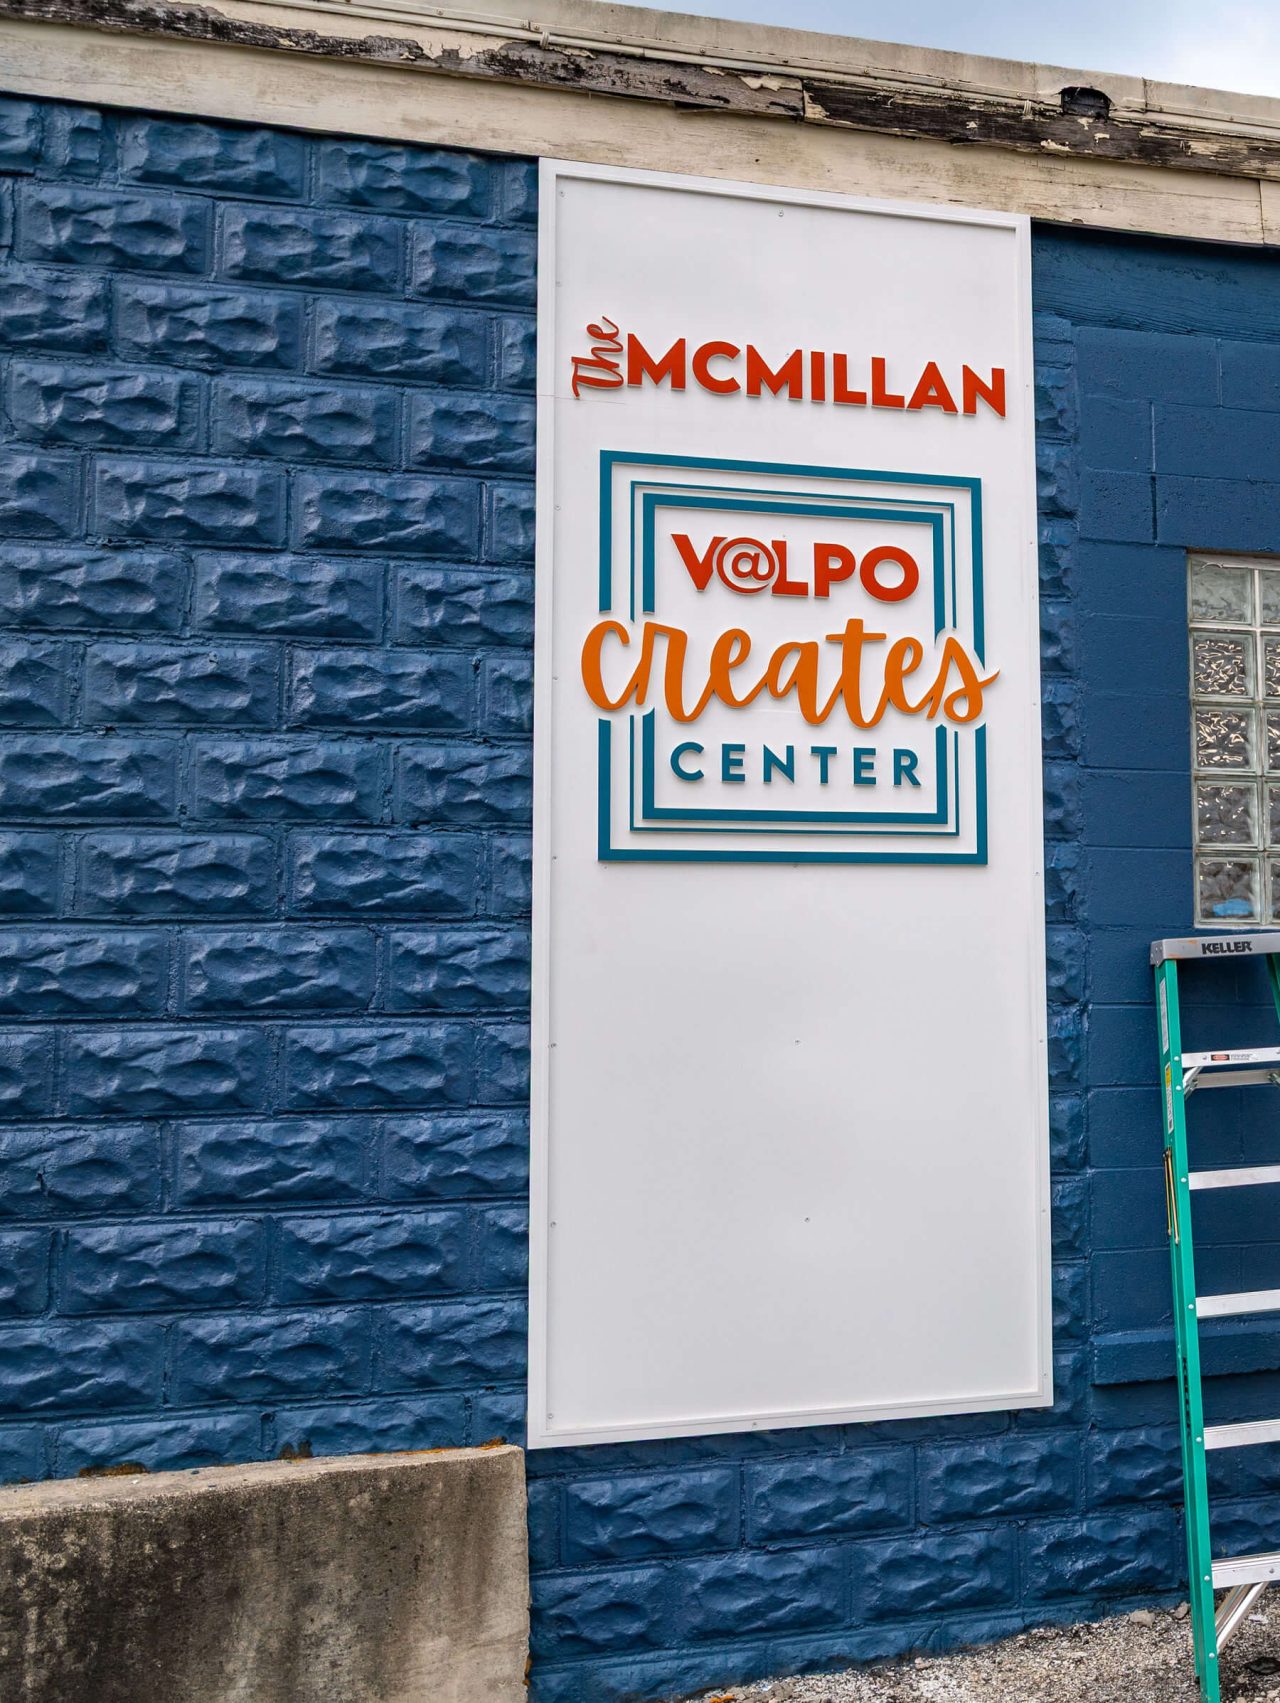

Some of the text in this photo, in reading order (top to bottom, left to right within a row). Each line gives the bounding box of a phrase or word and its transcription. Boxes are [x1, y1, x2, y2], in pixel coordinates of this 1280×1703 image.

[571, 316, 1006, 418] The MCMILLAN
[671, 533, 920, 603] V@LPO
[581, 618, 1000, 728] creates
[670, 741, 922, 786] CENTER
[1201, 941, 1253, 955] KELLER
